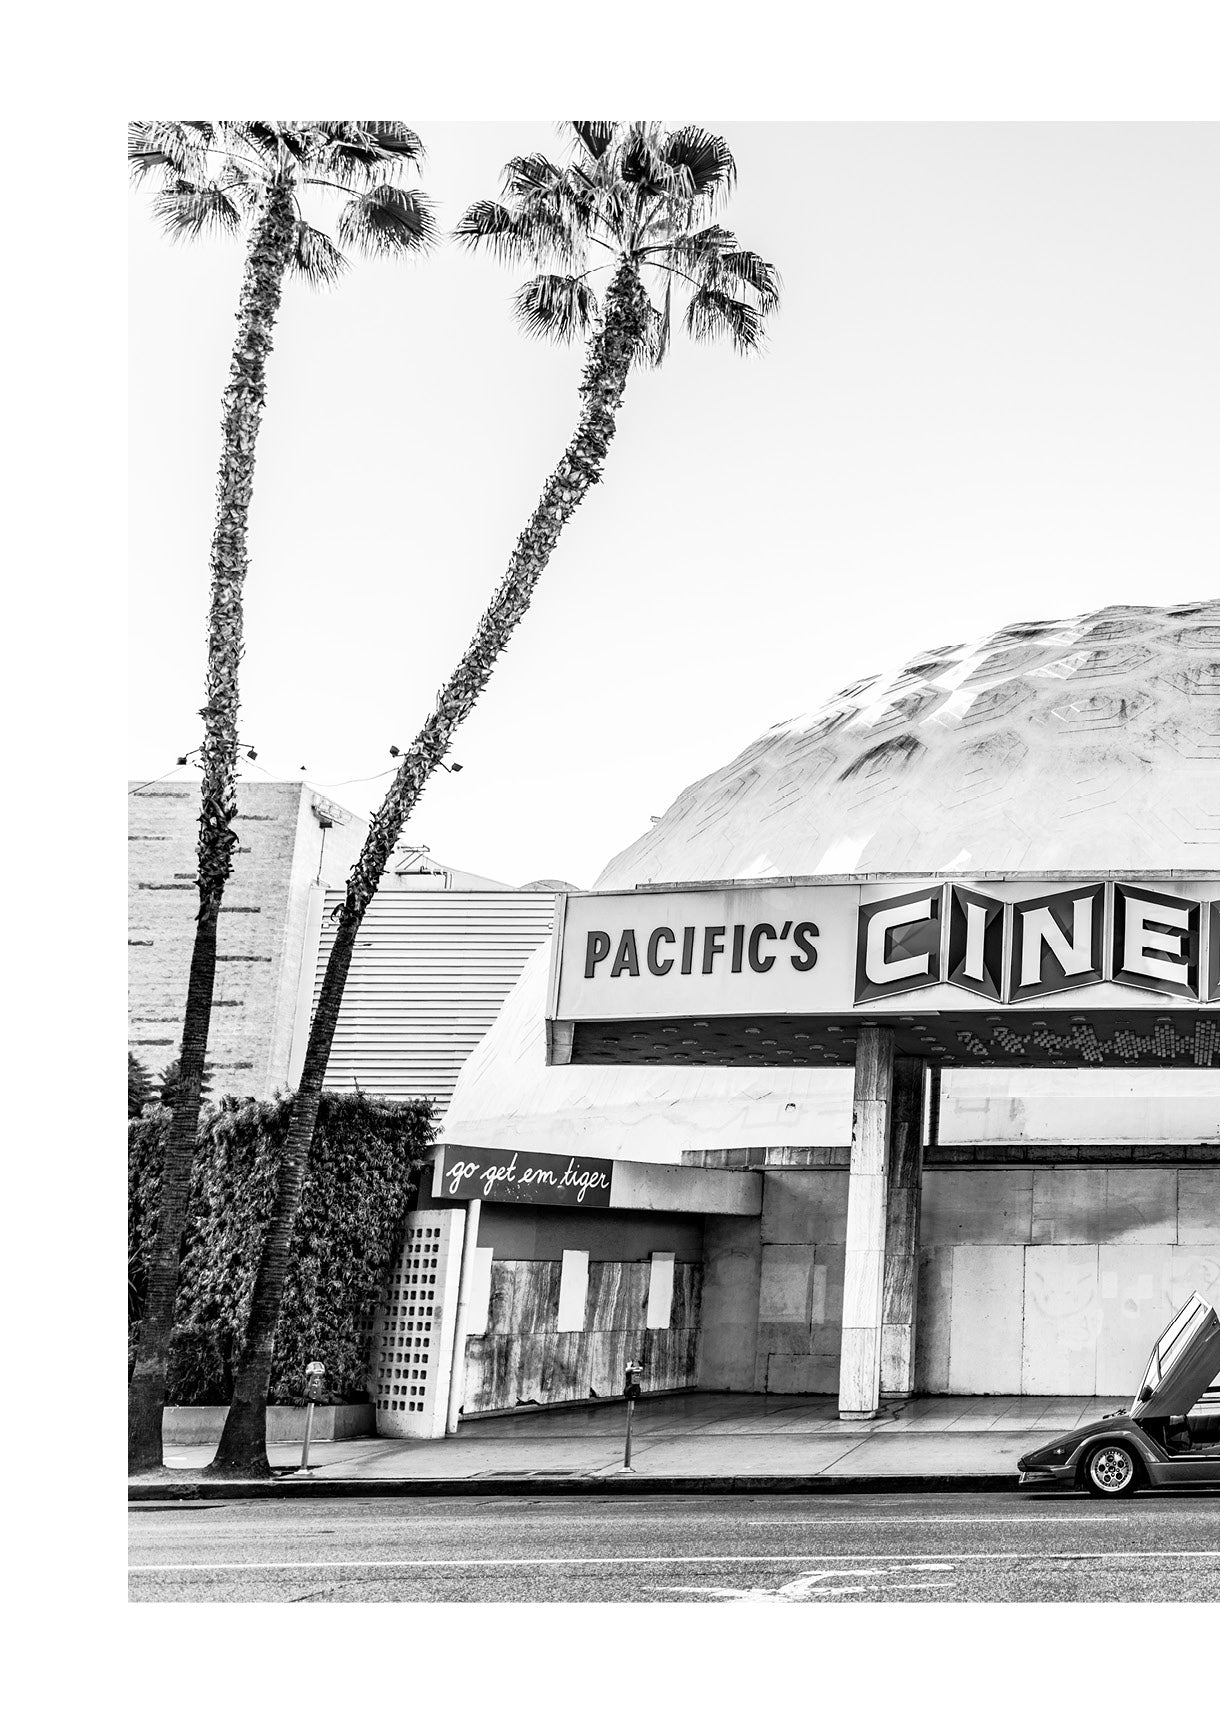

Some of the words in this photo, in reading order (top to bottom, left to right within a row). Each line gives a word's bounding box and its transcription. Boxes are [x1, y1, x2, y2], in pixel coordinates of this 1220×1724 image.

[583, 919, 821, 979] PACIFIC'S
[446, 1161, 480, 1194] go
[480, 1152, 518, 1196] get
[518, 1168, 558, 1185] em
[560, 1157, 610, 1203] tiger
